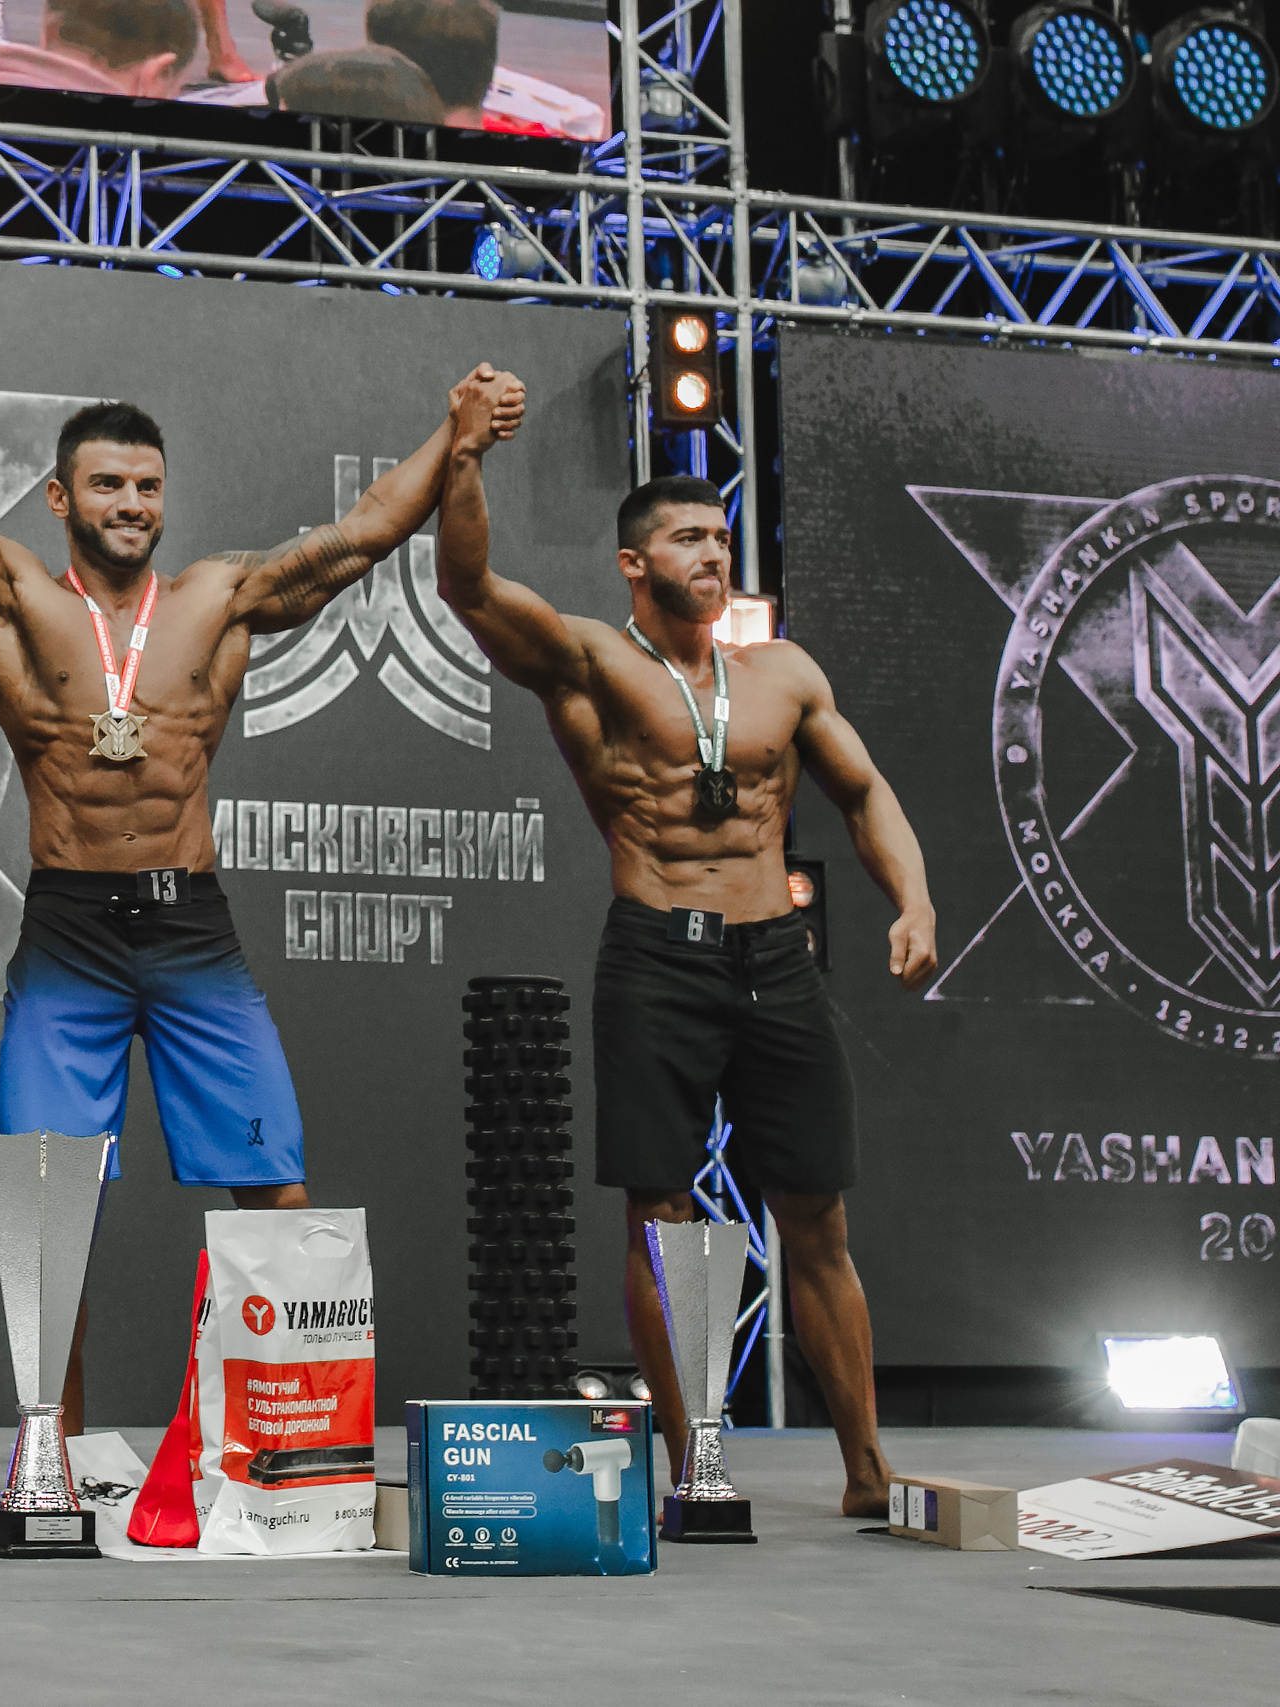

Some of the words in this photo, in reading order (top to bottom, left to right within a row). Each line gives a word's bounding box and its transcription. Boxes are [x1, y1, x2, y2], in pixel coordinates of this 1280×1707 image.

[1010, 509, 1160, 690] YASHANKIN
[150, 870, 177, 902] 13
[1019, 818, 1110, 973] МОСКВА
[285, 889, 453, 965] СПОРТ
[687, 910, 705, 942] 6
[1010, 1131, 1277, 1185] YASHAN
[1200, 1211, 1277, 1261] 20
[303, 1333, 331, 1344] ТОЛЬКО
[334, 1331, 362, 1342] ЛУЧШЕЕ
[247, 1378, 300, 1395] #ЯМОГУЧИЙ
[255, 1395, 338, 1415] УЛЬТРАКОМПАКТНОЙ
[249, 1417, 283, 1435] БЕГОВОЙ
[284, 1415, 330, 1436] ДОРОЖКОЙ
[442, 1423, 537, 1442] FASCIAL
[443, 1447, 491, 1466] GUN
[446, 1474, 476, 1482] CY-801
